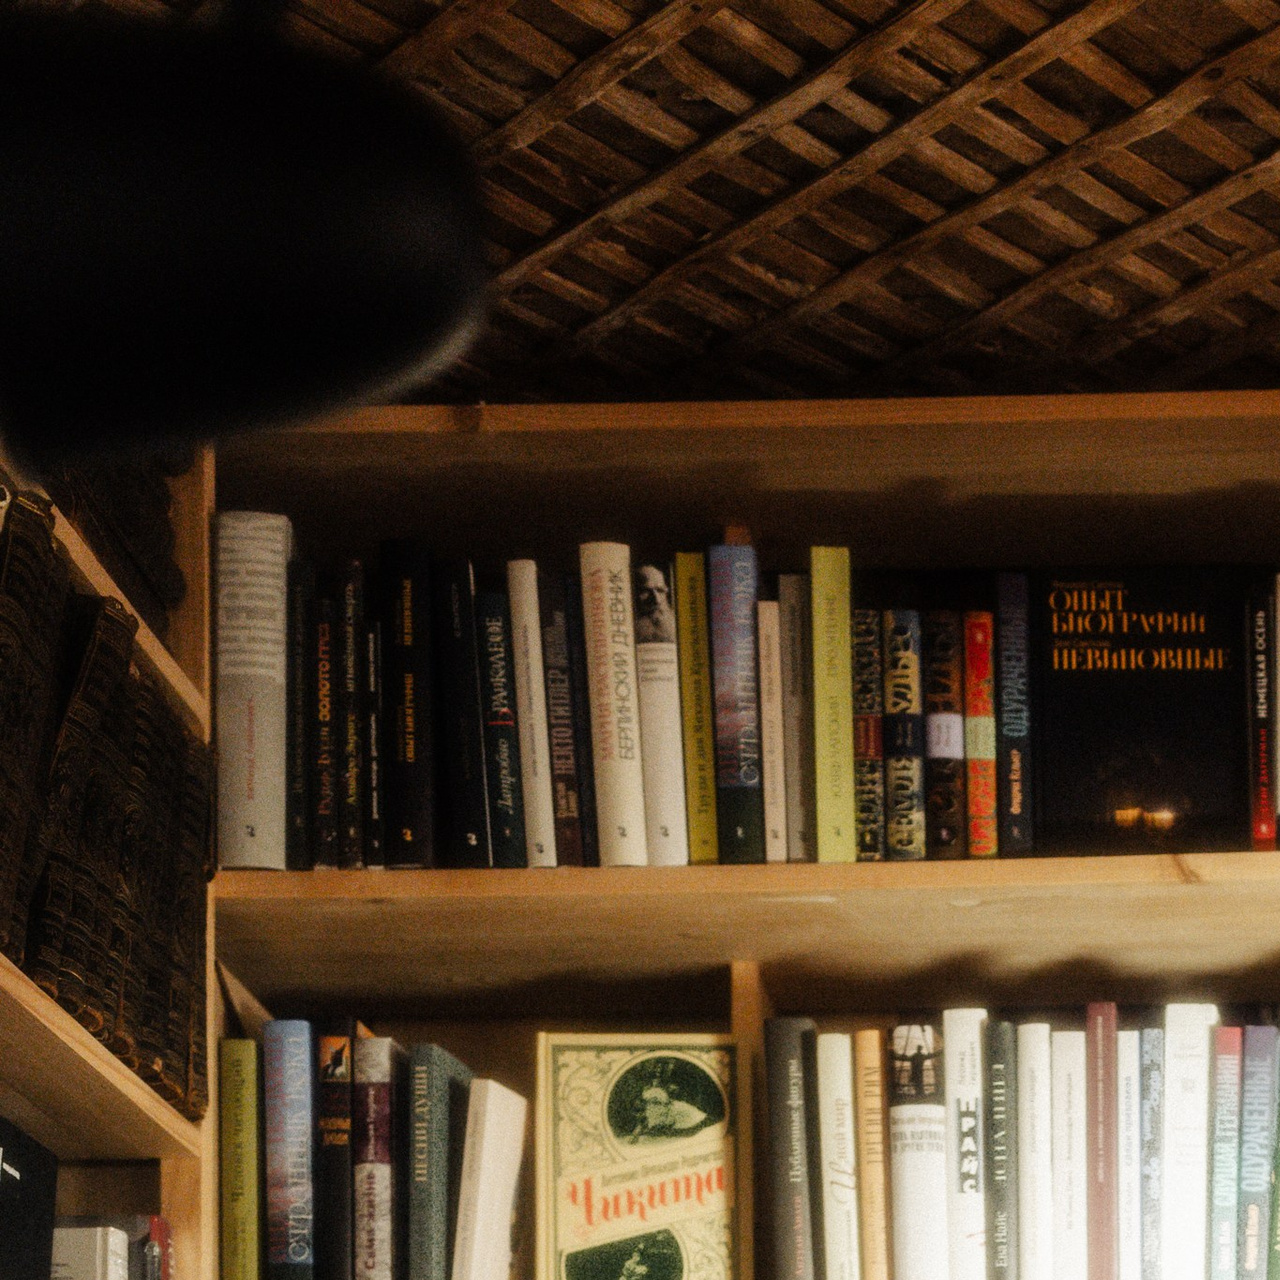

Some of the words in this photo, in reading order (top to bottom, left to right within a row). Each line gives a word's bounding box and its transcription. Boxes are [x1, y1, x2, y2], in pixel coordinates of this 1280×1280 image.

[609, 568, 629, 646] ДНЕВНИК
[1049, 589, 1127, 611] ОПЫТ
[1052, 612, 1206, 633] БИОГРАФИИ
[1254, 610, 1267, 650] ОСЕНЬ
[1052, 648, 1229, 670] НЕВИНОВНЫЕ
[614, 653, 633, 760] БЕРЛИНСКИЙ
[787, 1059, 803, 1108] фигуры
[789, 1111, 804, 1183] Публичные
[1242, 1054, 1274, 1193] ОДУРАЧЕННЫЕ
